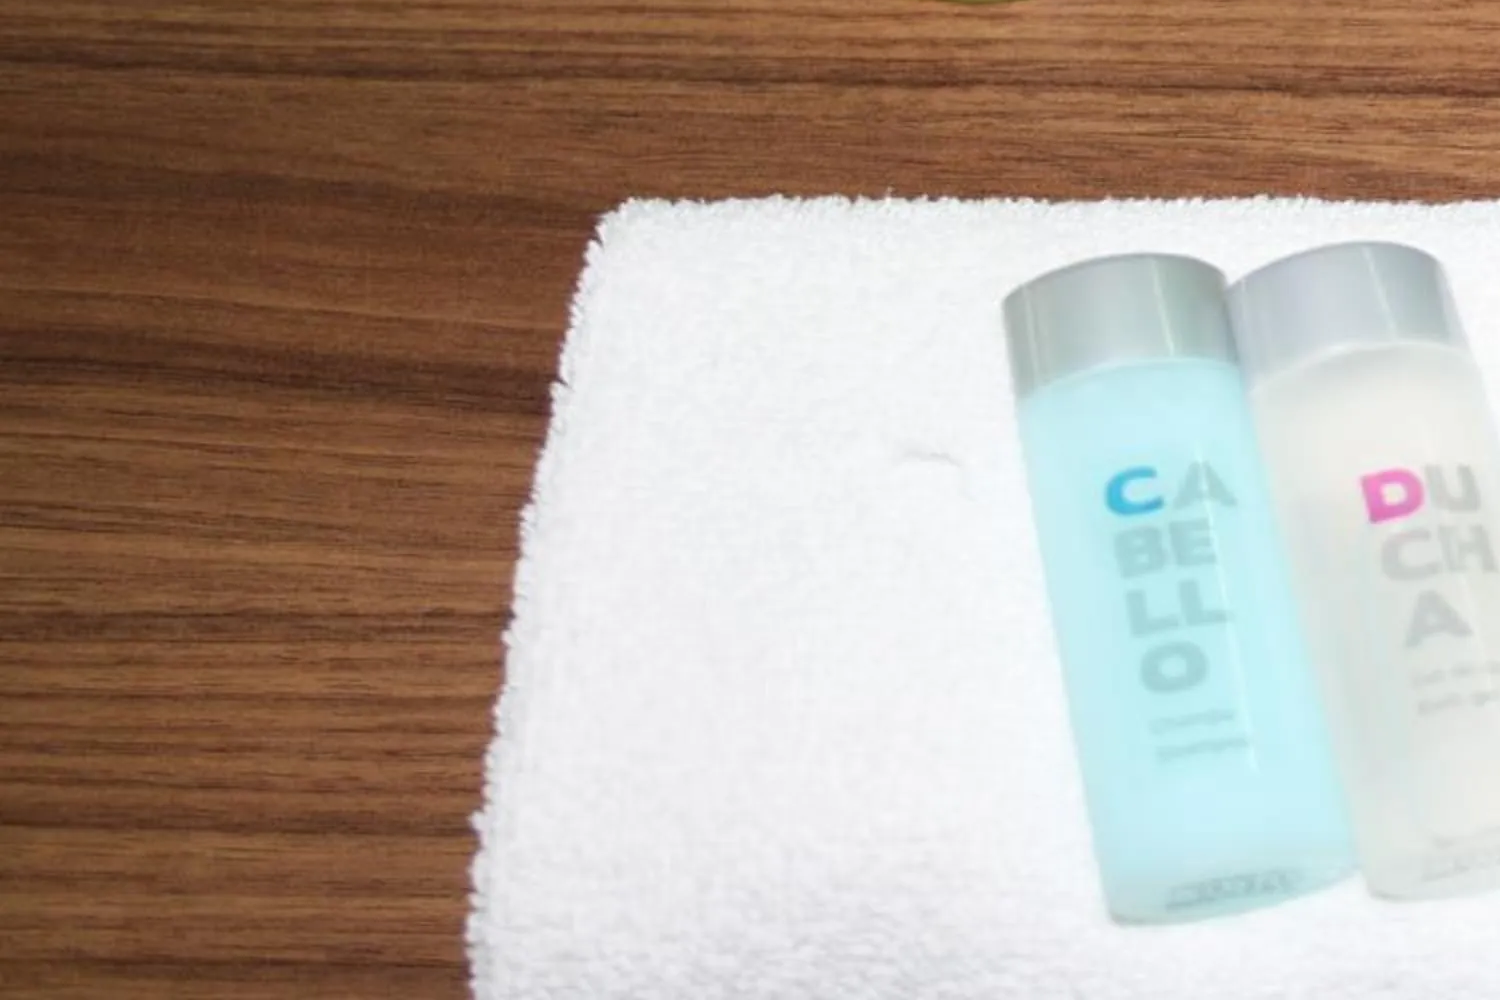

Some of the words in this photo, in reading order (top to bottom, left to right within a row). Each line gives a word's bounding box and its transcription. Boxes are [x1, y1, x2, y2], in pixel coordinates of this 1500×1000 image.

[1105, 462, 1237, 515] CA
[1358, 463, 1481, 524] DU
[1116, 519, 1217, 579] BE
[1382, 525, 1496, 580] CH
[1128, 580, 1229, 637] LL
[1404, 590, 1473, 649] A
[1141, 642, 1206, 692] O
